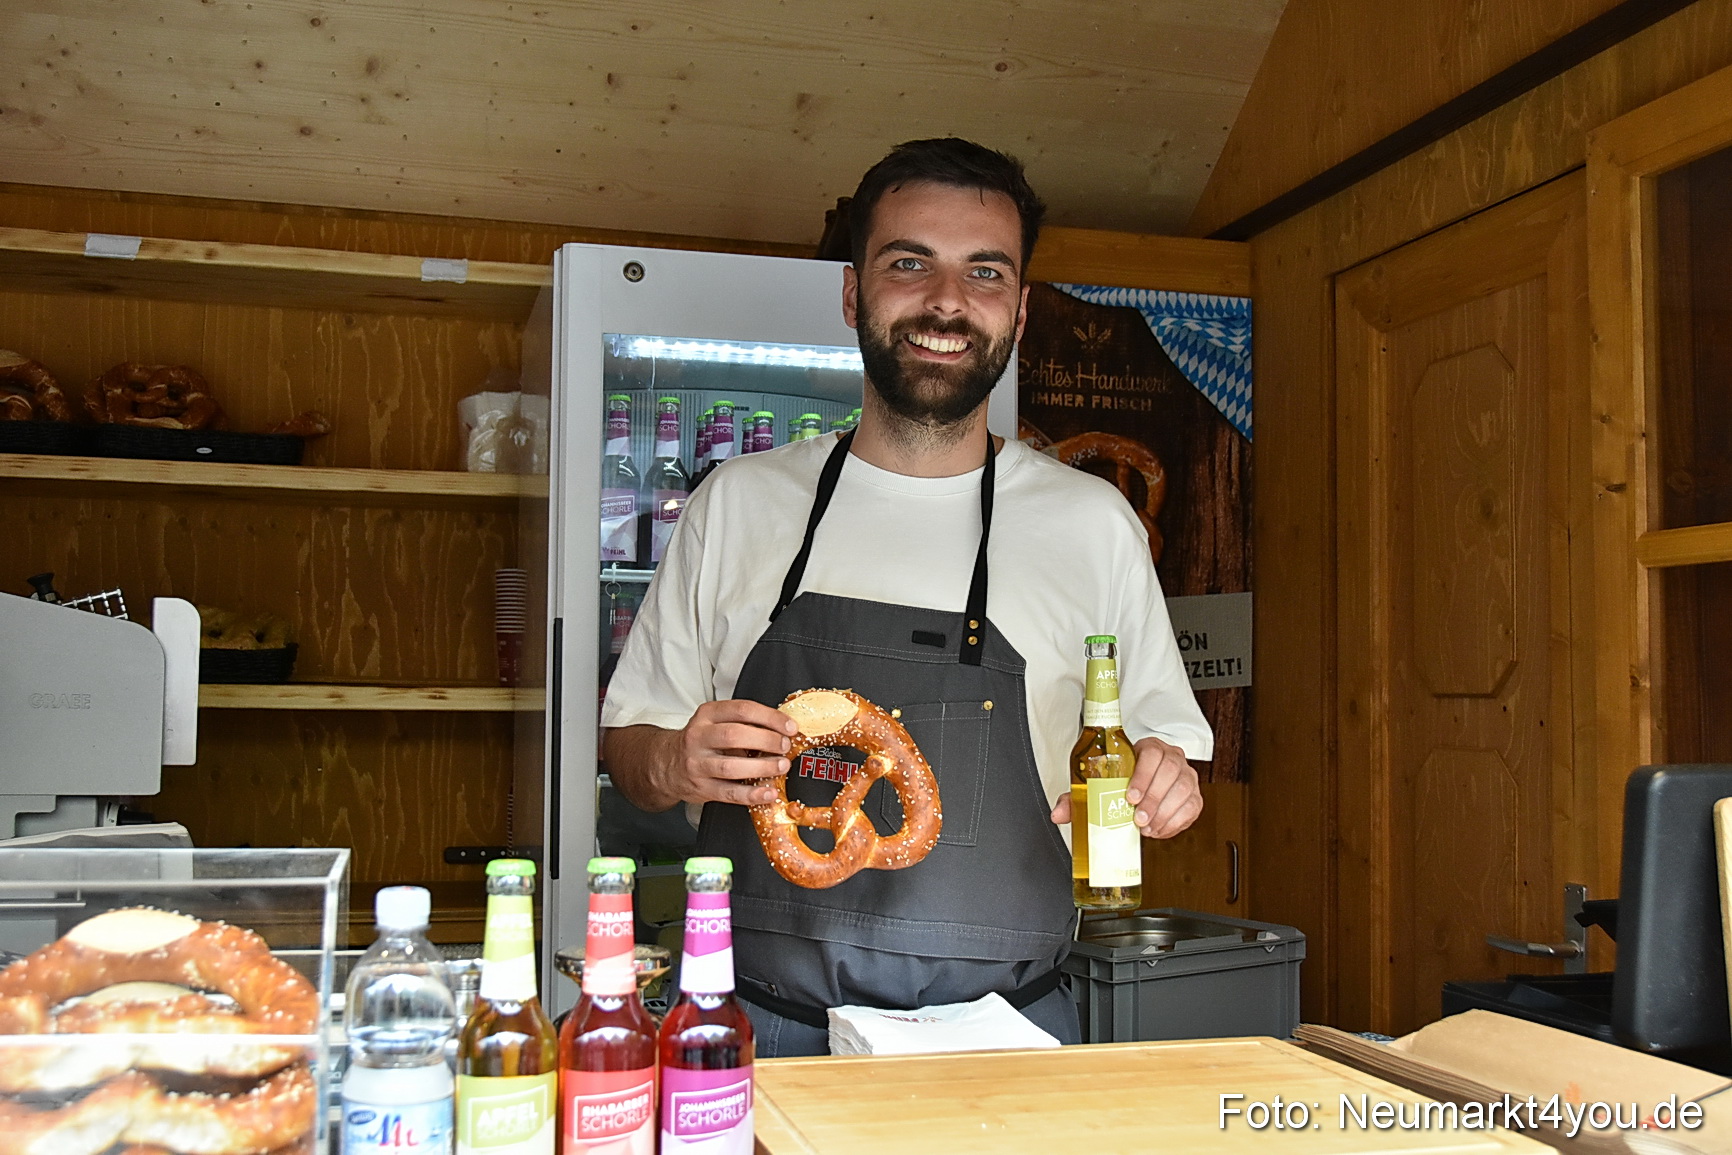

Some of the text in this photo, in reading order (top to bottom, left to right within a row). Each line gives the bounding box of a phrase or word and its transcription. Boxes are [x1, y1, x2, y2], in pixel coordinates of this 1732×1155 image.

[1075, 361, 1174, 395] Handwerk
[1031, 390, 1152, 412] IMMER FRISCH
[662, 508, 683, 517] SCHO
[1177, 630, 1208, 651] ÖN
[476, 1101, 539, 1128] APFEL
[582, 1093, 650, 1117] RHABARBER
[678, 1102, 746, 1129] SCHORLE
[581, 1105, 649, 1132] SCHORLE
